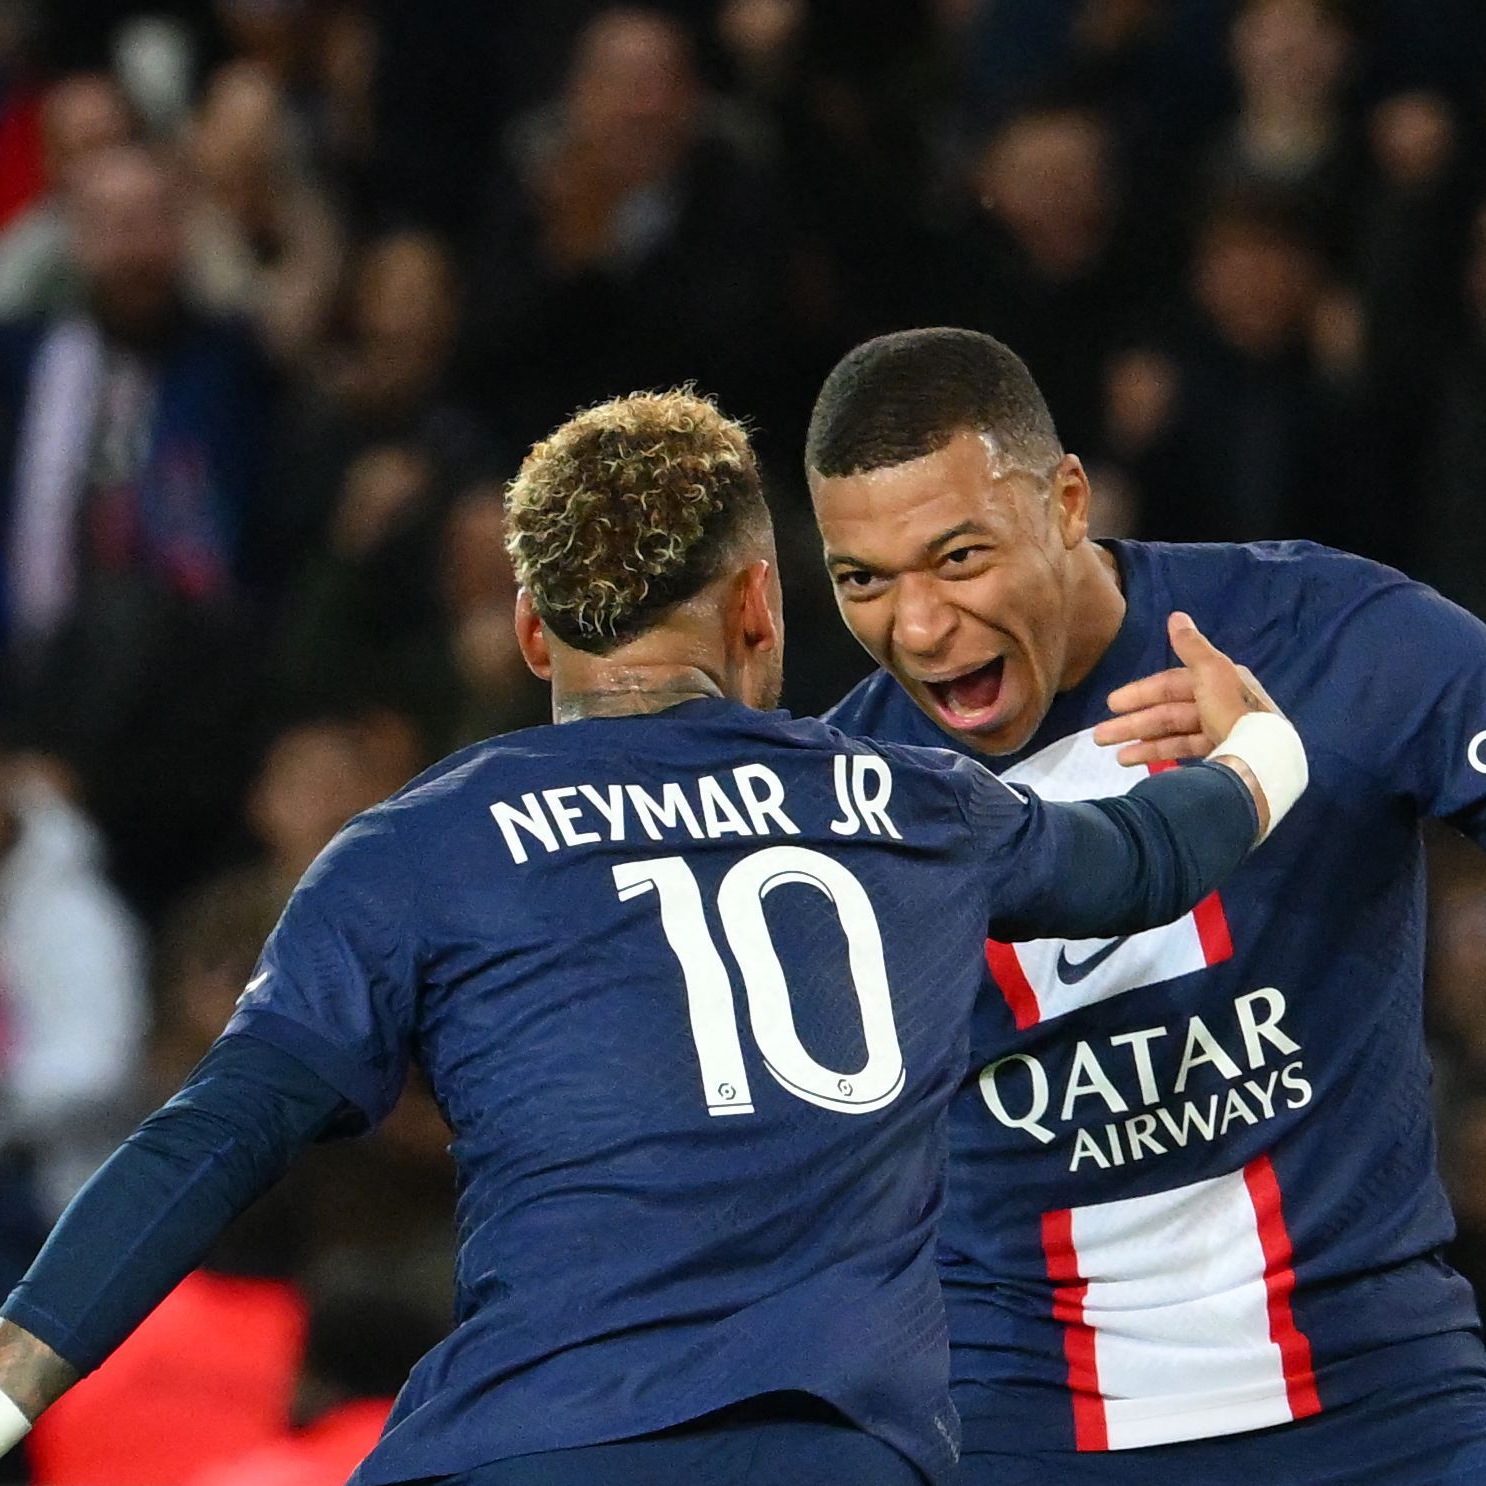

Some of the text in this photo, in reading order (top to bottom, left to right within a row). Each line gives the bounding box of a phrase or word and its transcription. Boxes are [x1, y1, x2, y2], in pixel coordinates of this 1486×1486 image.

[490, 755, 904, 864] NEYMAR JR
[614, 845, 907, 1117] 10
[978, 986, 1302, 1143] QATAR
[1068, 1062, 1313, 1173] AIRWAYS
